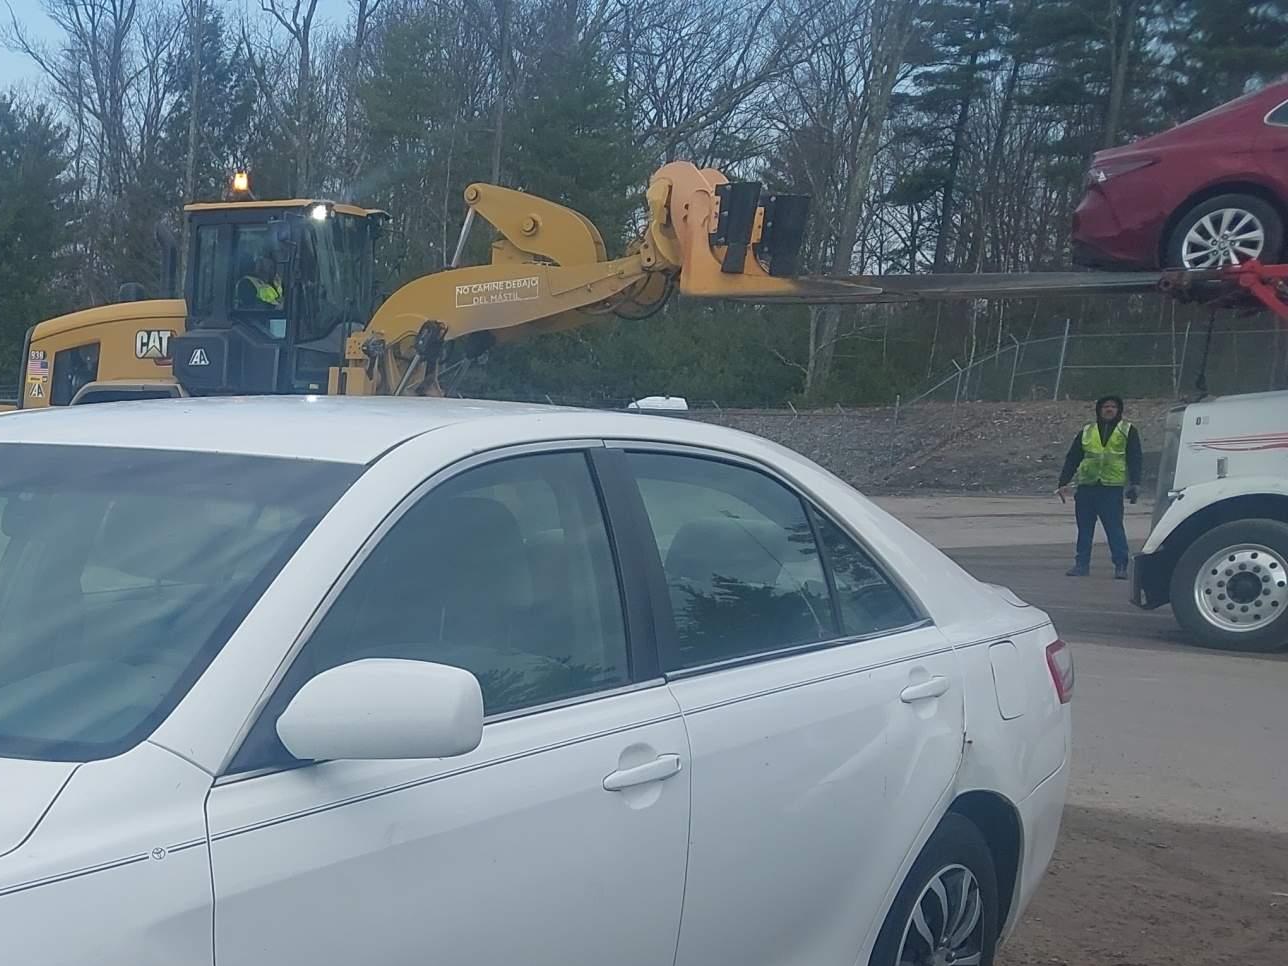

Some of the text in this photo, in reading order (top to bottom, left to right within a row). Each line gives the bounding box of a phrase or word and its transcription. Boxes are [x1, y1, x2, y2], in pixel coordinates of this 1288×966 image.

[457, 278, 537, 295] NO CAMINE DEBAJO
[136, 330, 171, 358] CAT
